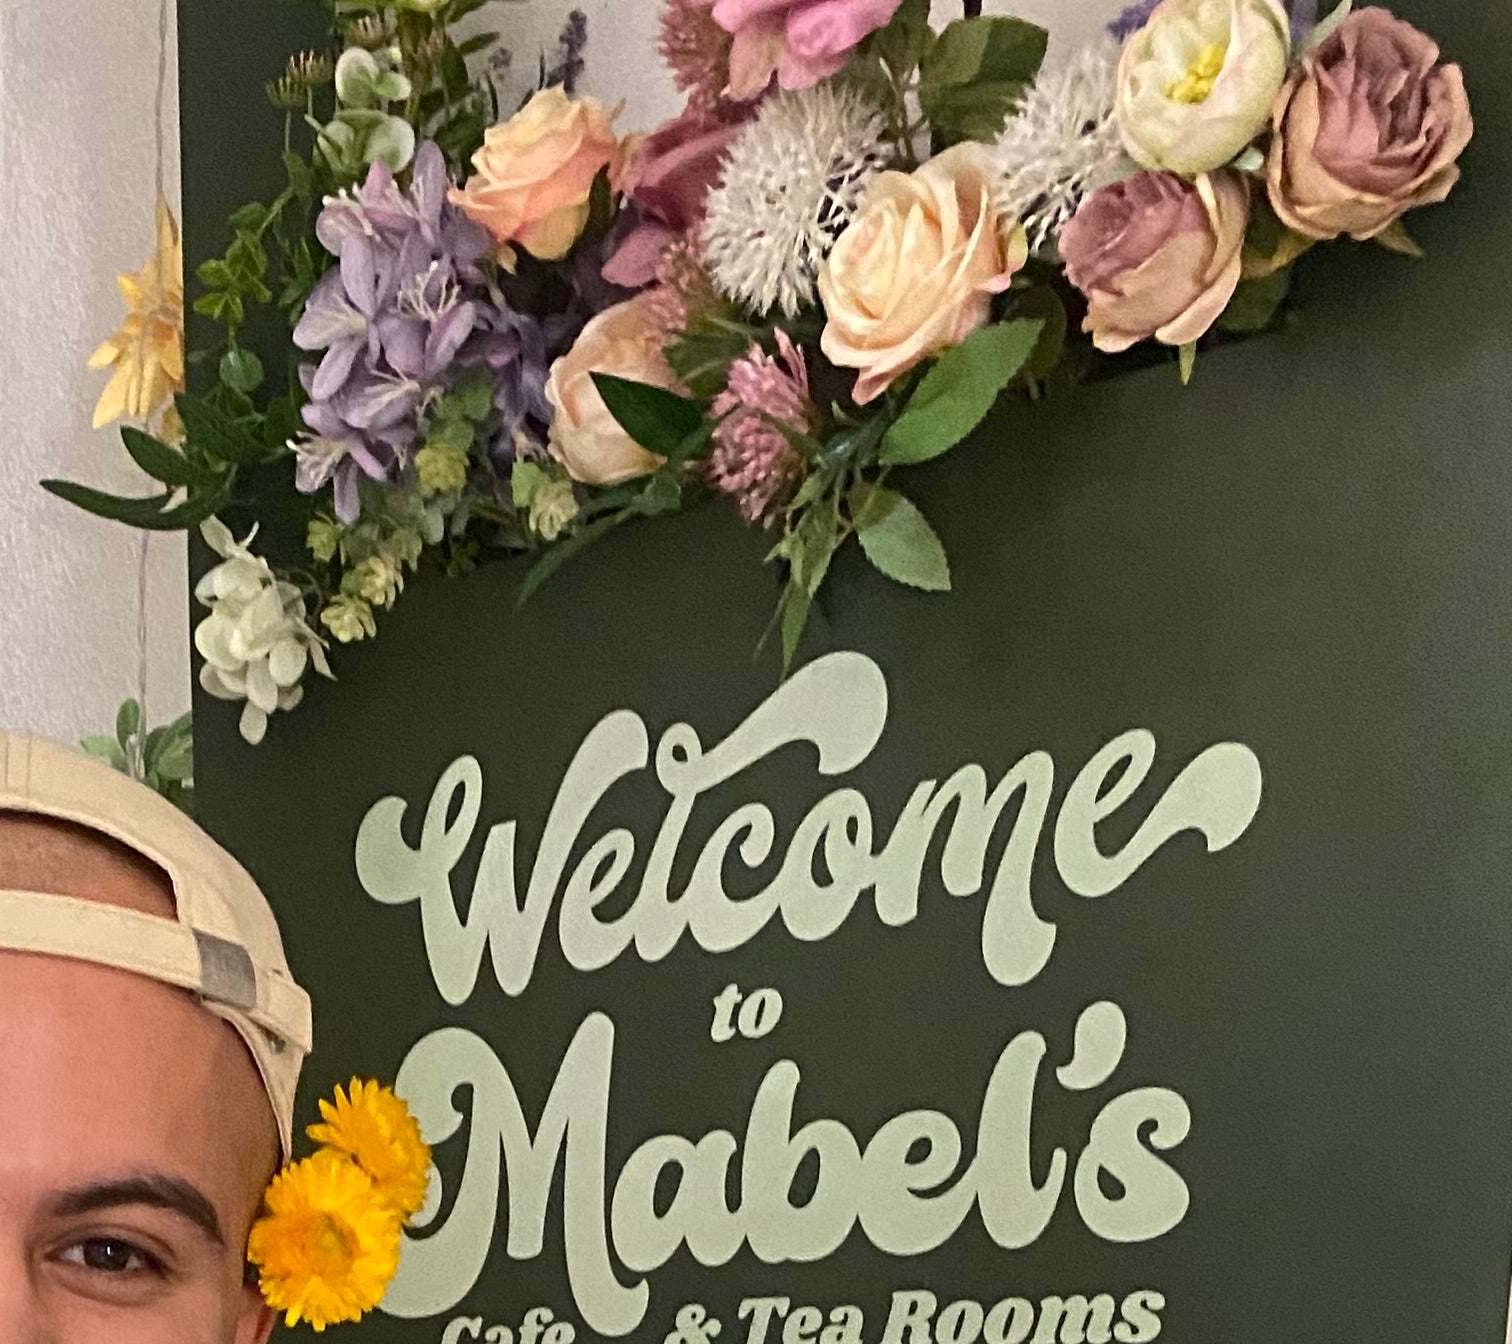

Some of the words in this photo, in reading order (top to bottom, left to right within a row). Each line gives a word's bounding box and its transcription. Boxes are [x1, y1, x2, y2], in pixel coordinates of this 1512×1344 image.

[355, 650, 1262, 1004] Welcome
[375, 1000, 1192, 1337] Mabel's
[709, 984, 784, 1042] to
